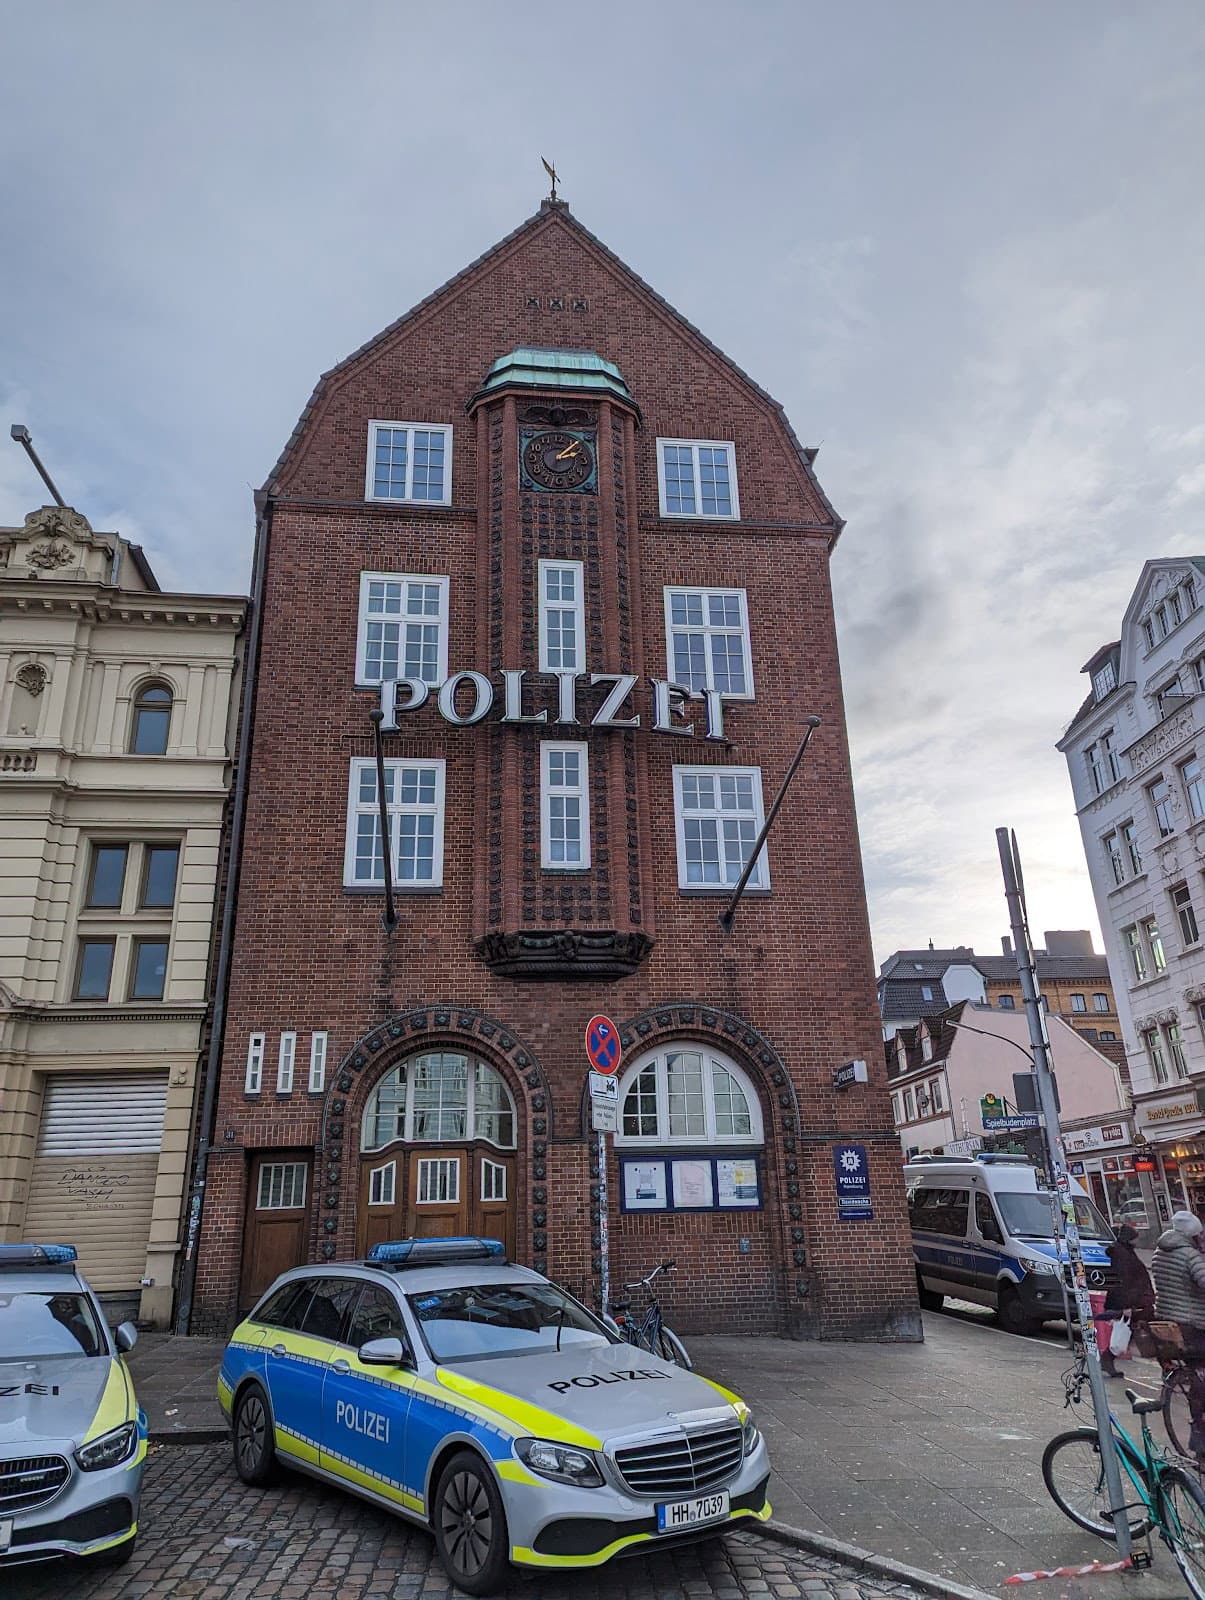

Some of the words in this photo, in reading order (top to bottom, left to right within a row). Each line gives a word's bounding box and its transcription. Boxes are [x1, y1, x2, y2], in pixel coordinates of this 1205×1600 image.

[533, 464, 541, 473] 8
[581, 457, 588, 465] 3
[577, 468, 584, 476] 4
[379, 669, 729, 742] POLIZEI
[985, 1118, 1037, 1129] Spielbudenplatz
[547, 1370, 672, 1394] POLIZEI
[336, 1399, 390, 1444] POLIZEI
[672, 1503, 689, 1524] HH
[696, 1495, 723, 1519] 7039
